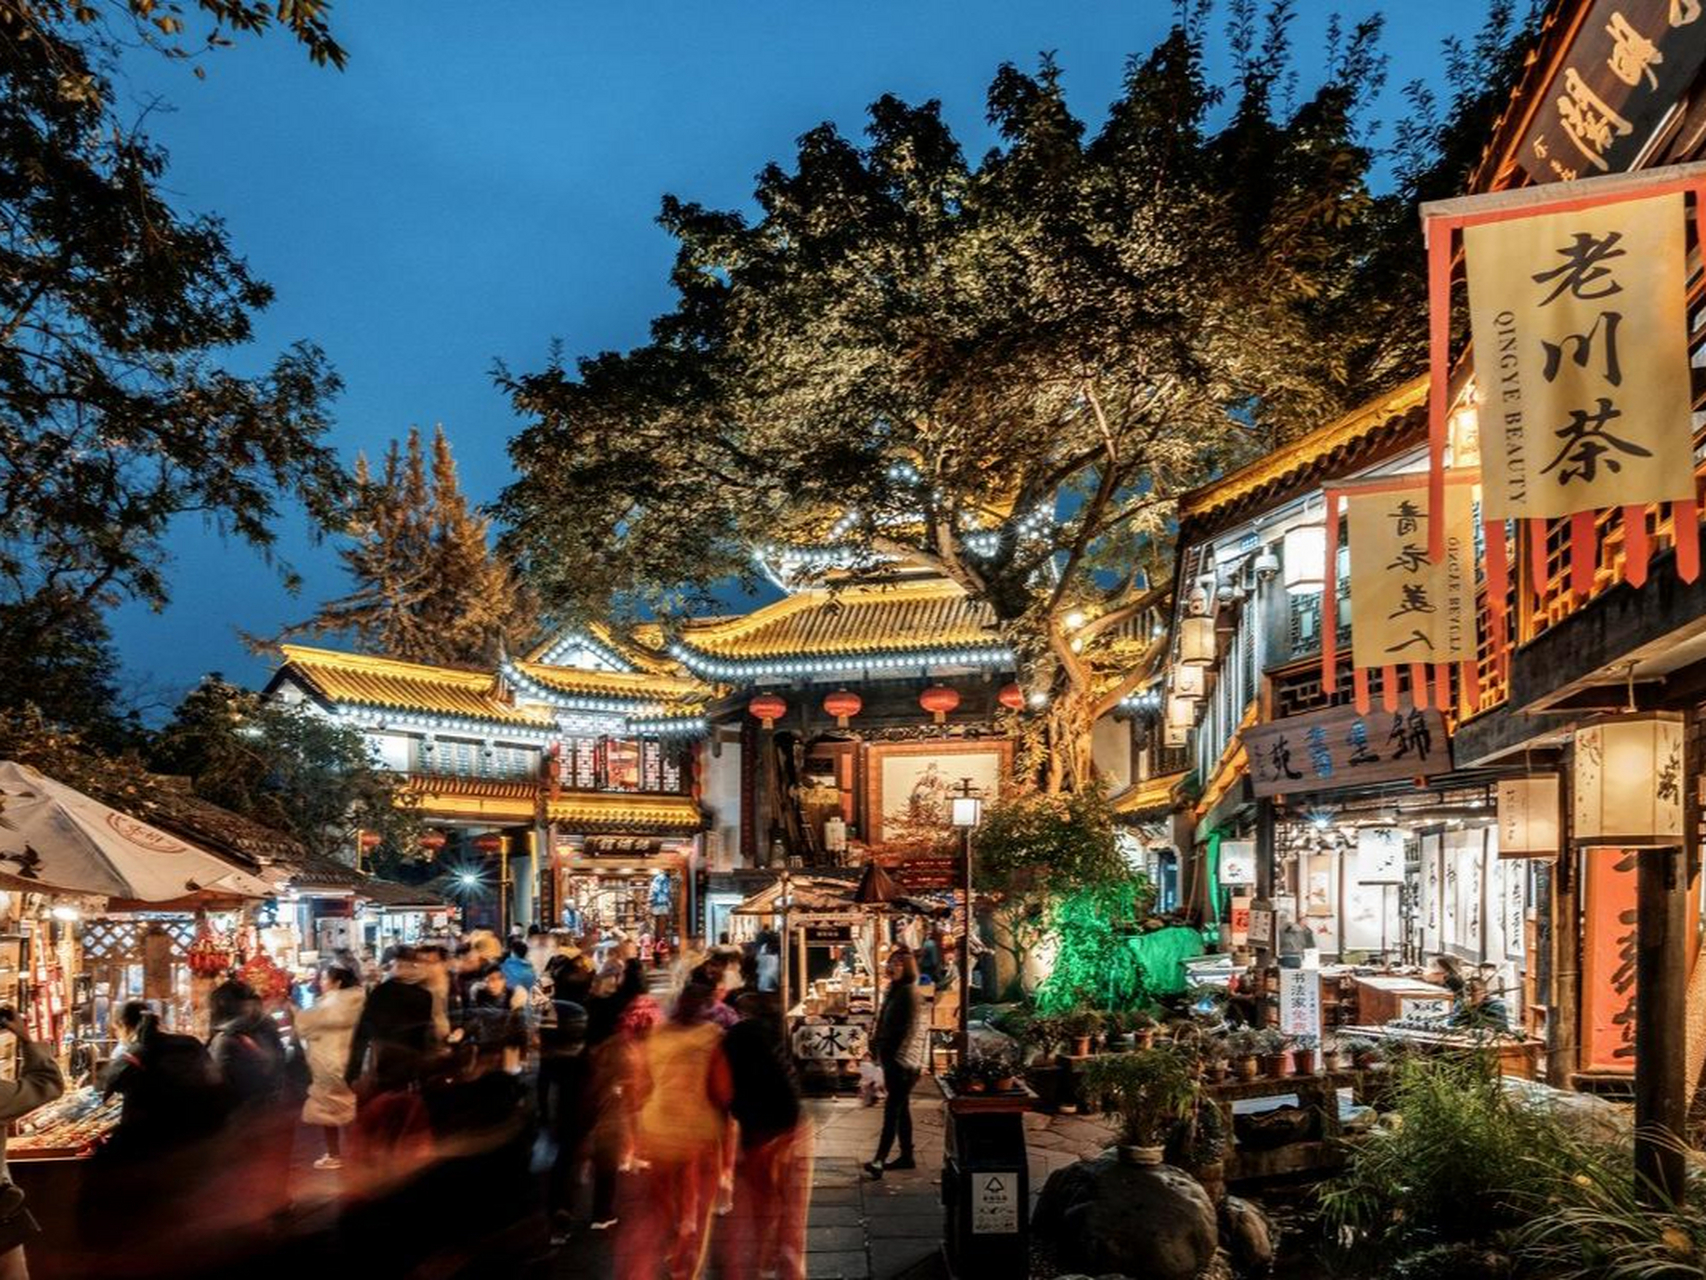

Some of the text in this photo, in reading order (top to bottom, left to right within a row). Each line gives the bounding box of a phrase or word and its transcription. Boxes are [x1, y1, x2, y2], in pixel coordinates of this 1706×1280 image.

[1493, 310, 1527, 504] QINGYE BEAUTY
[1531, 231, 1653, 486] 老川茶
